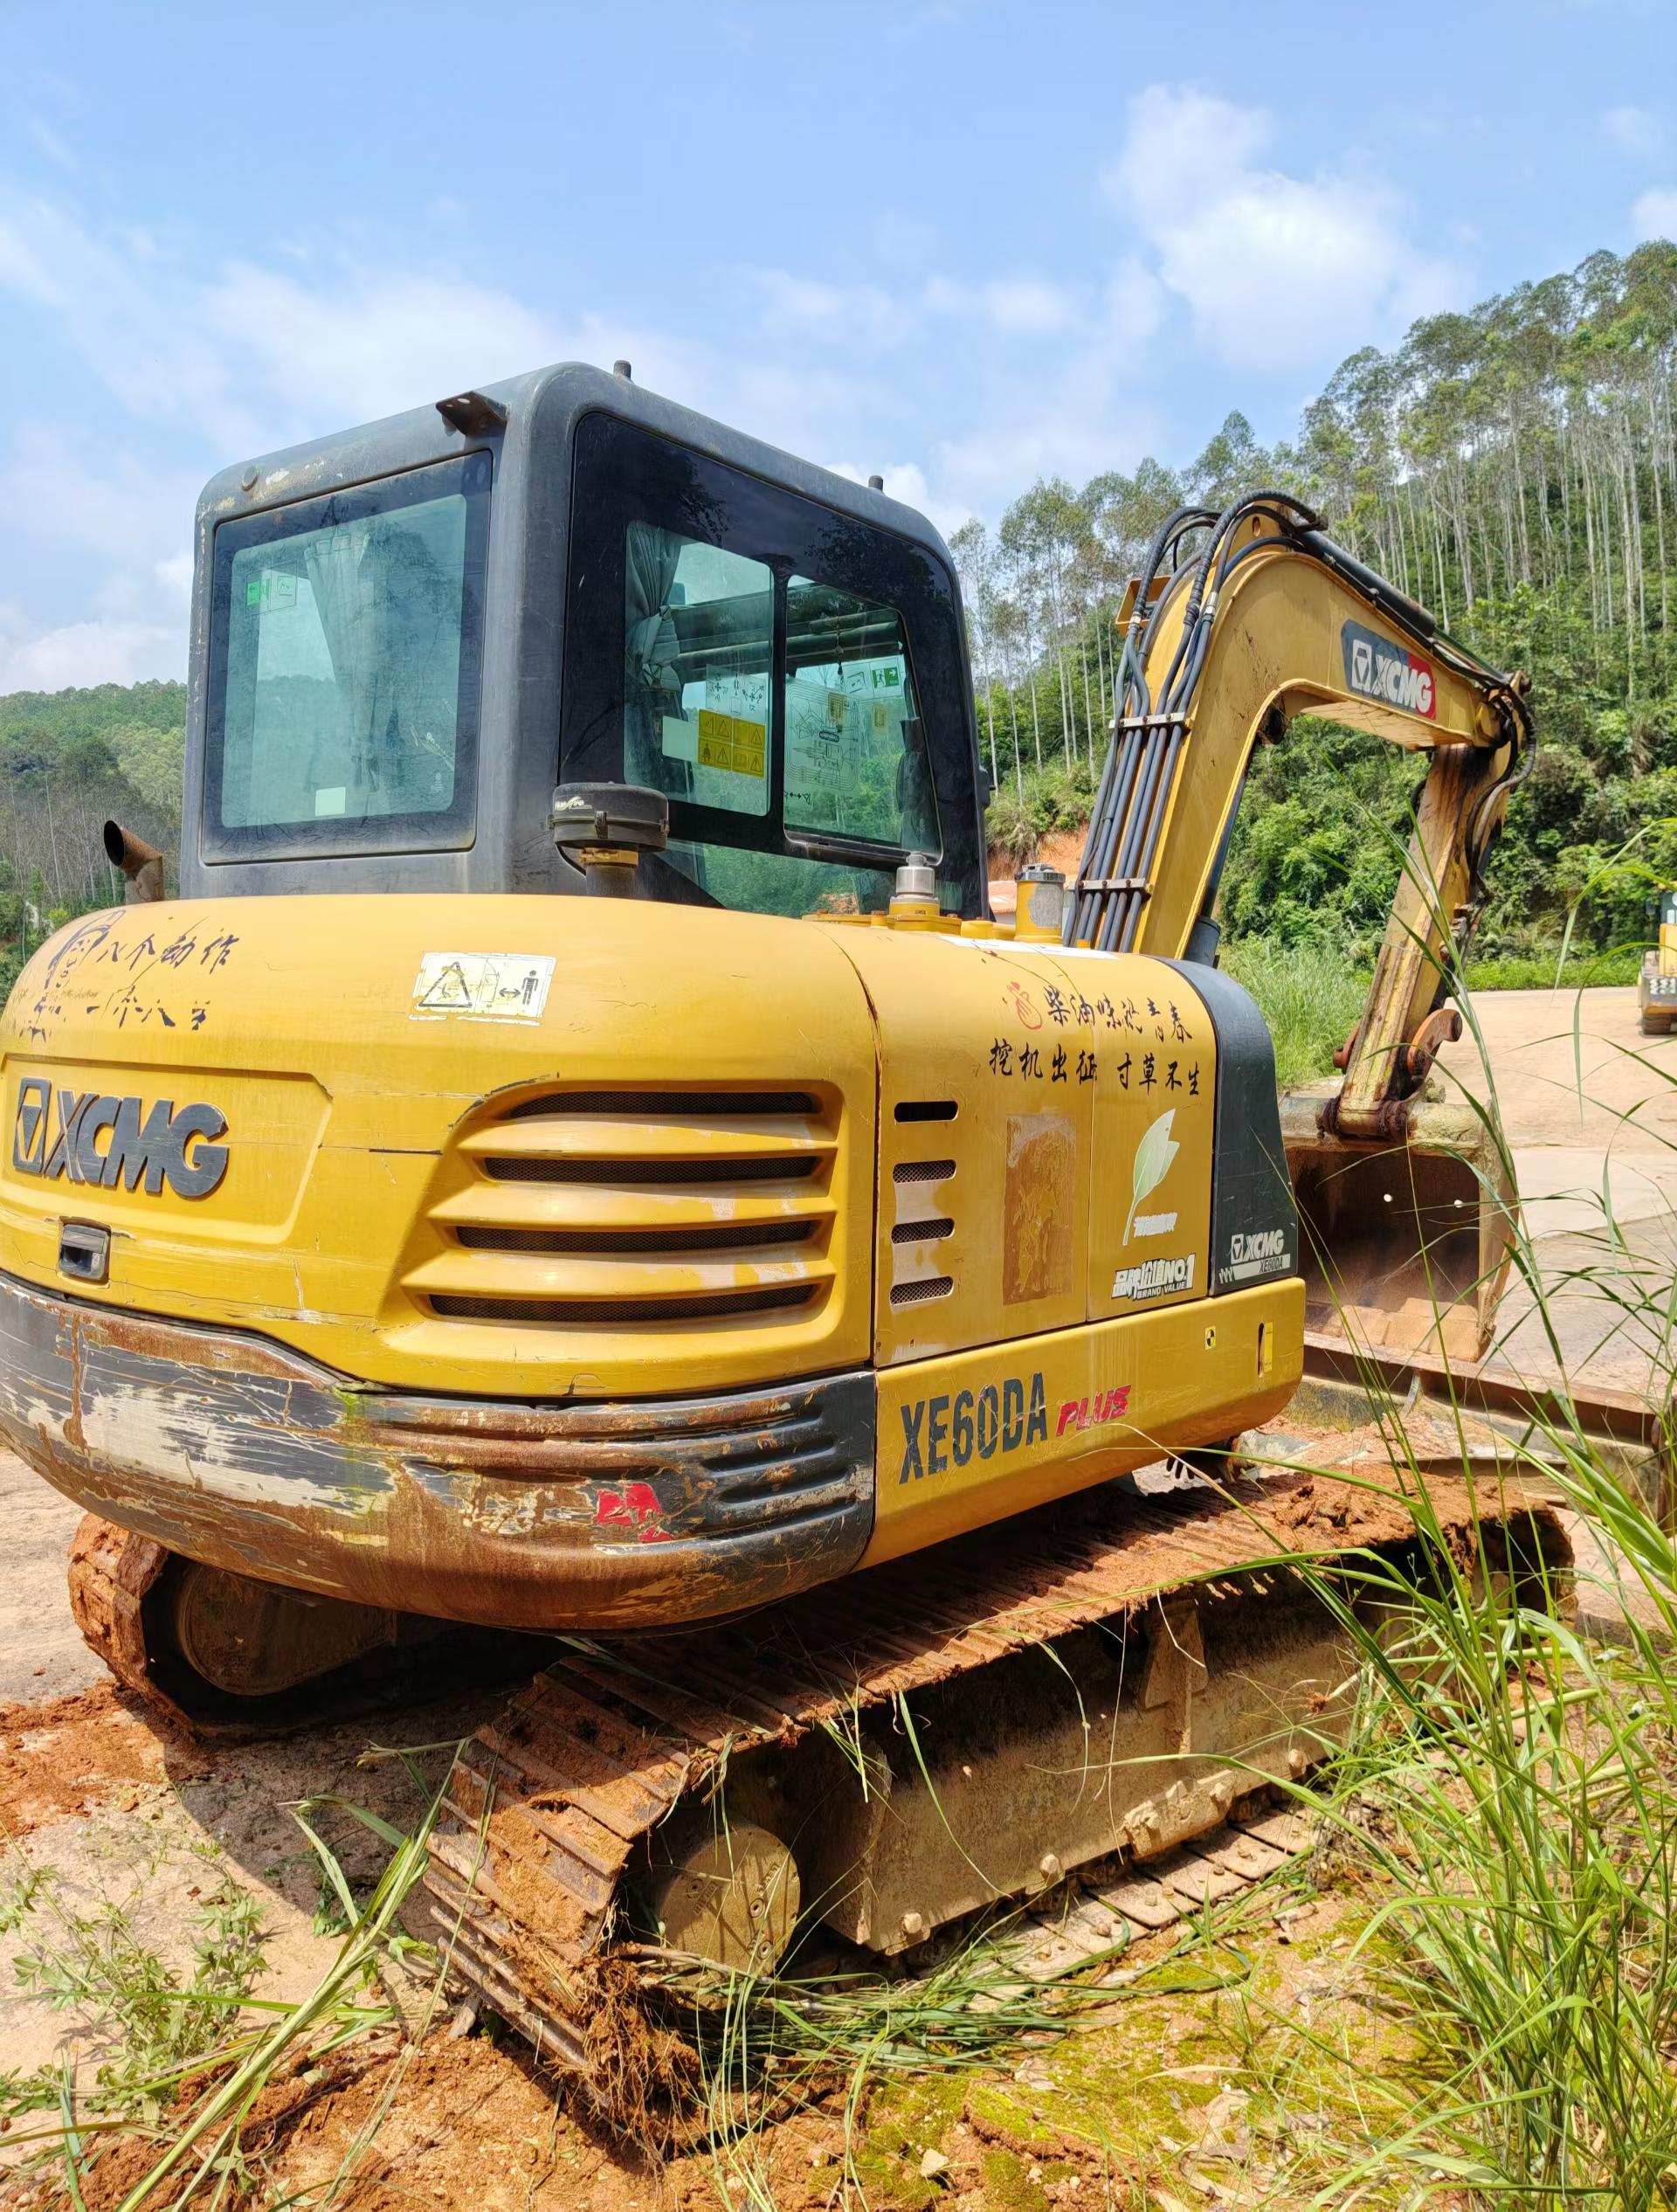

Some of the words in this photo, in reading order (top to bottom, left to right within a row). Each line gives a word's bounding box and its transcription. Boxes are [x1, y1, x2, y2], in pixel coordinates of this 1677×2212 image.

[1371, 655, 1432, 713] XCMG
[989, 1037, 1098, 1086] 挖机出征
[1116, 1052, 1200, 1096] 寸草不生
[45, 1089, 230, 1198] XCMG
[1242, 1229, 1285, 1262] XCMG
[1136, 1286, 1162, 1300] BRAND
[1163, 1281, 1187, 1295] VALUE
[899, 1372, 1047, 1484] XE60DA
[1055, 1384, 1132, 1437] PLUS
